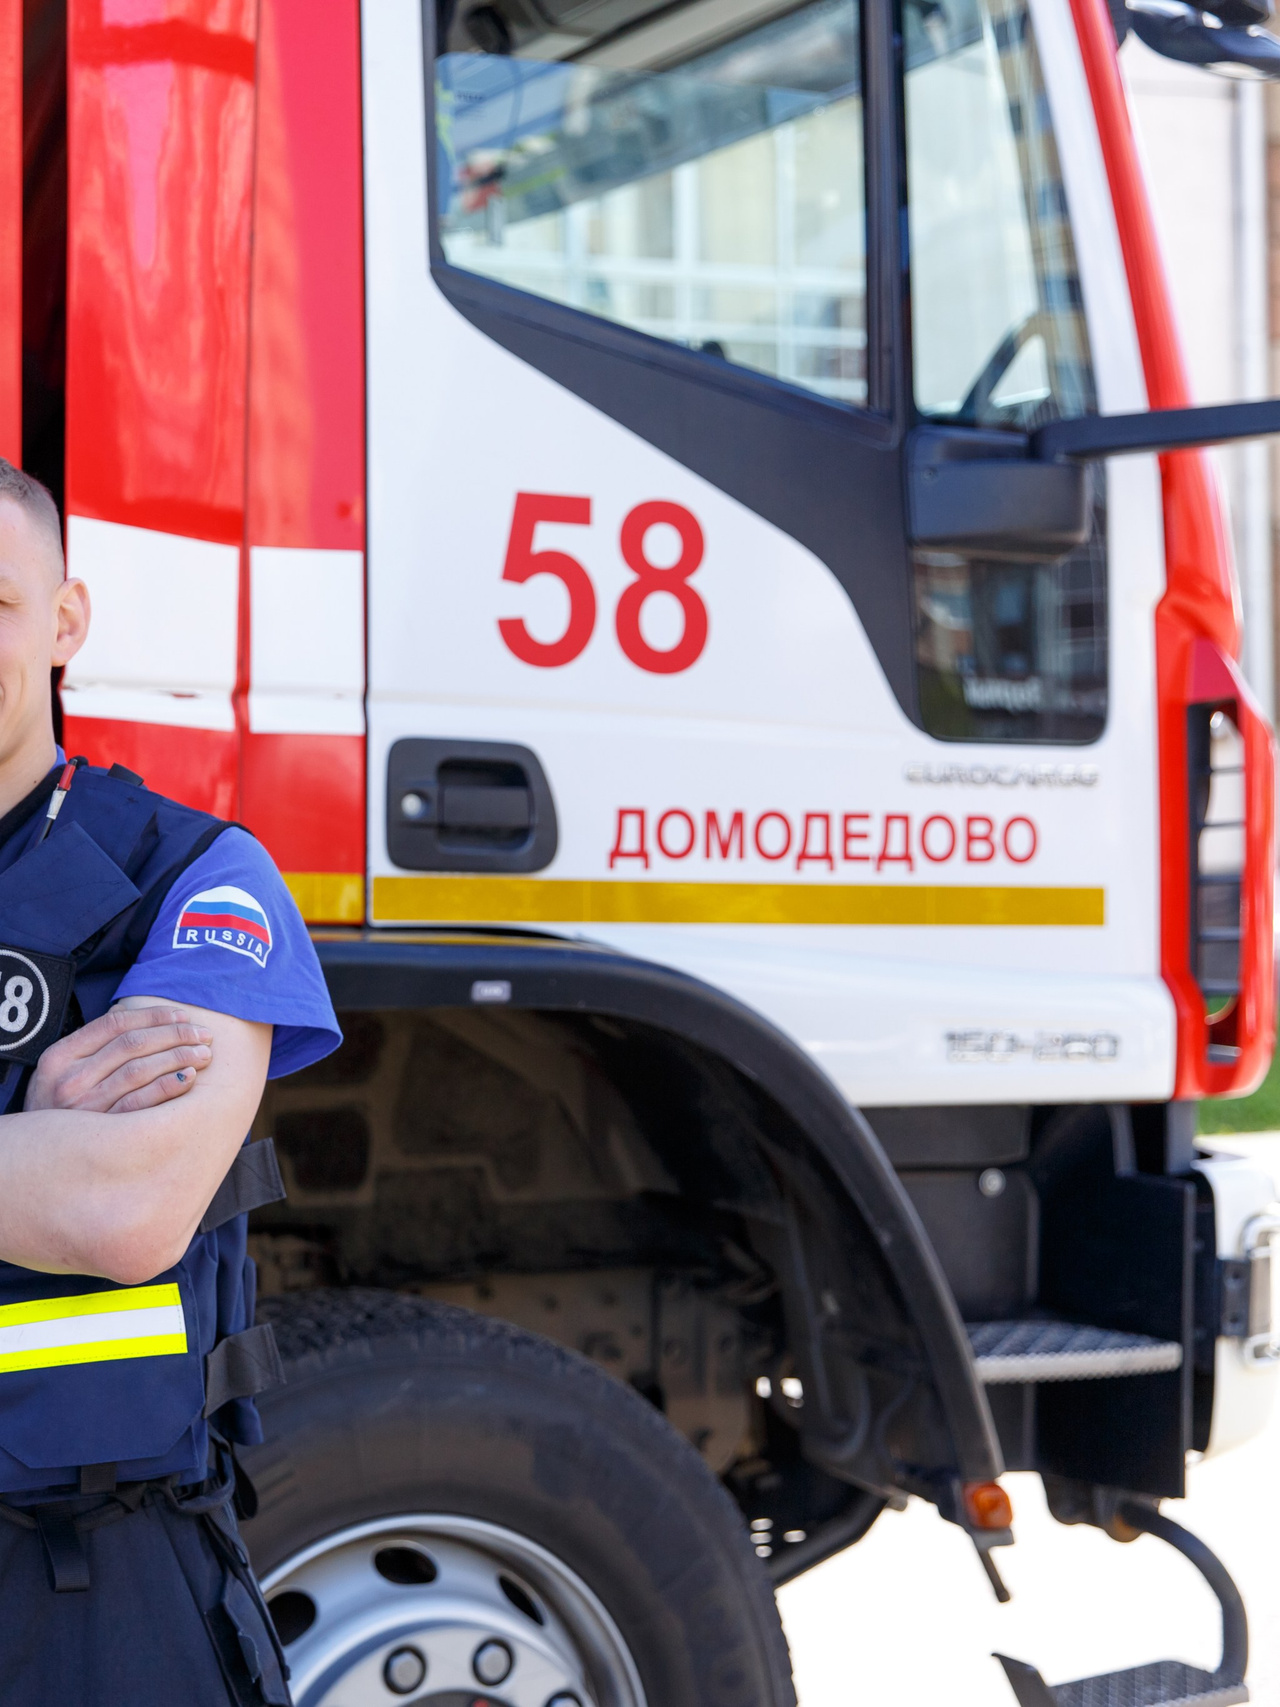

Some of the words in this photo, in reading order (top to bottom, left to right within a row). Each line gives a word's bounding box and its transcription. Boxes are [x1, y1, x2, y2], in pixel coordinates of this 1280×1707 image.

[497, 491, 709, 675] 58
[609, 807, 1039, 873] ДОМОДЕДОВО
[186, 928, 263, 957] RUSSIA
